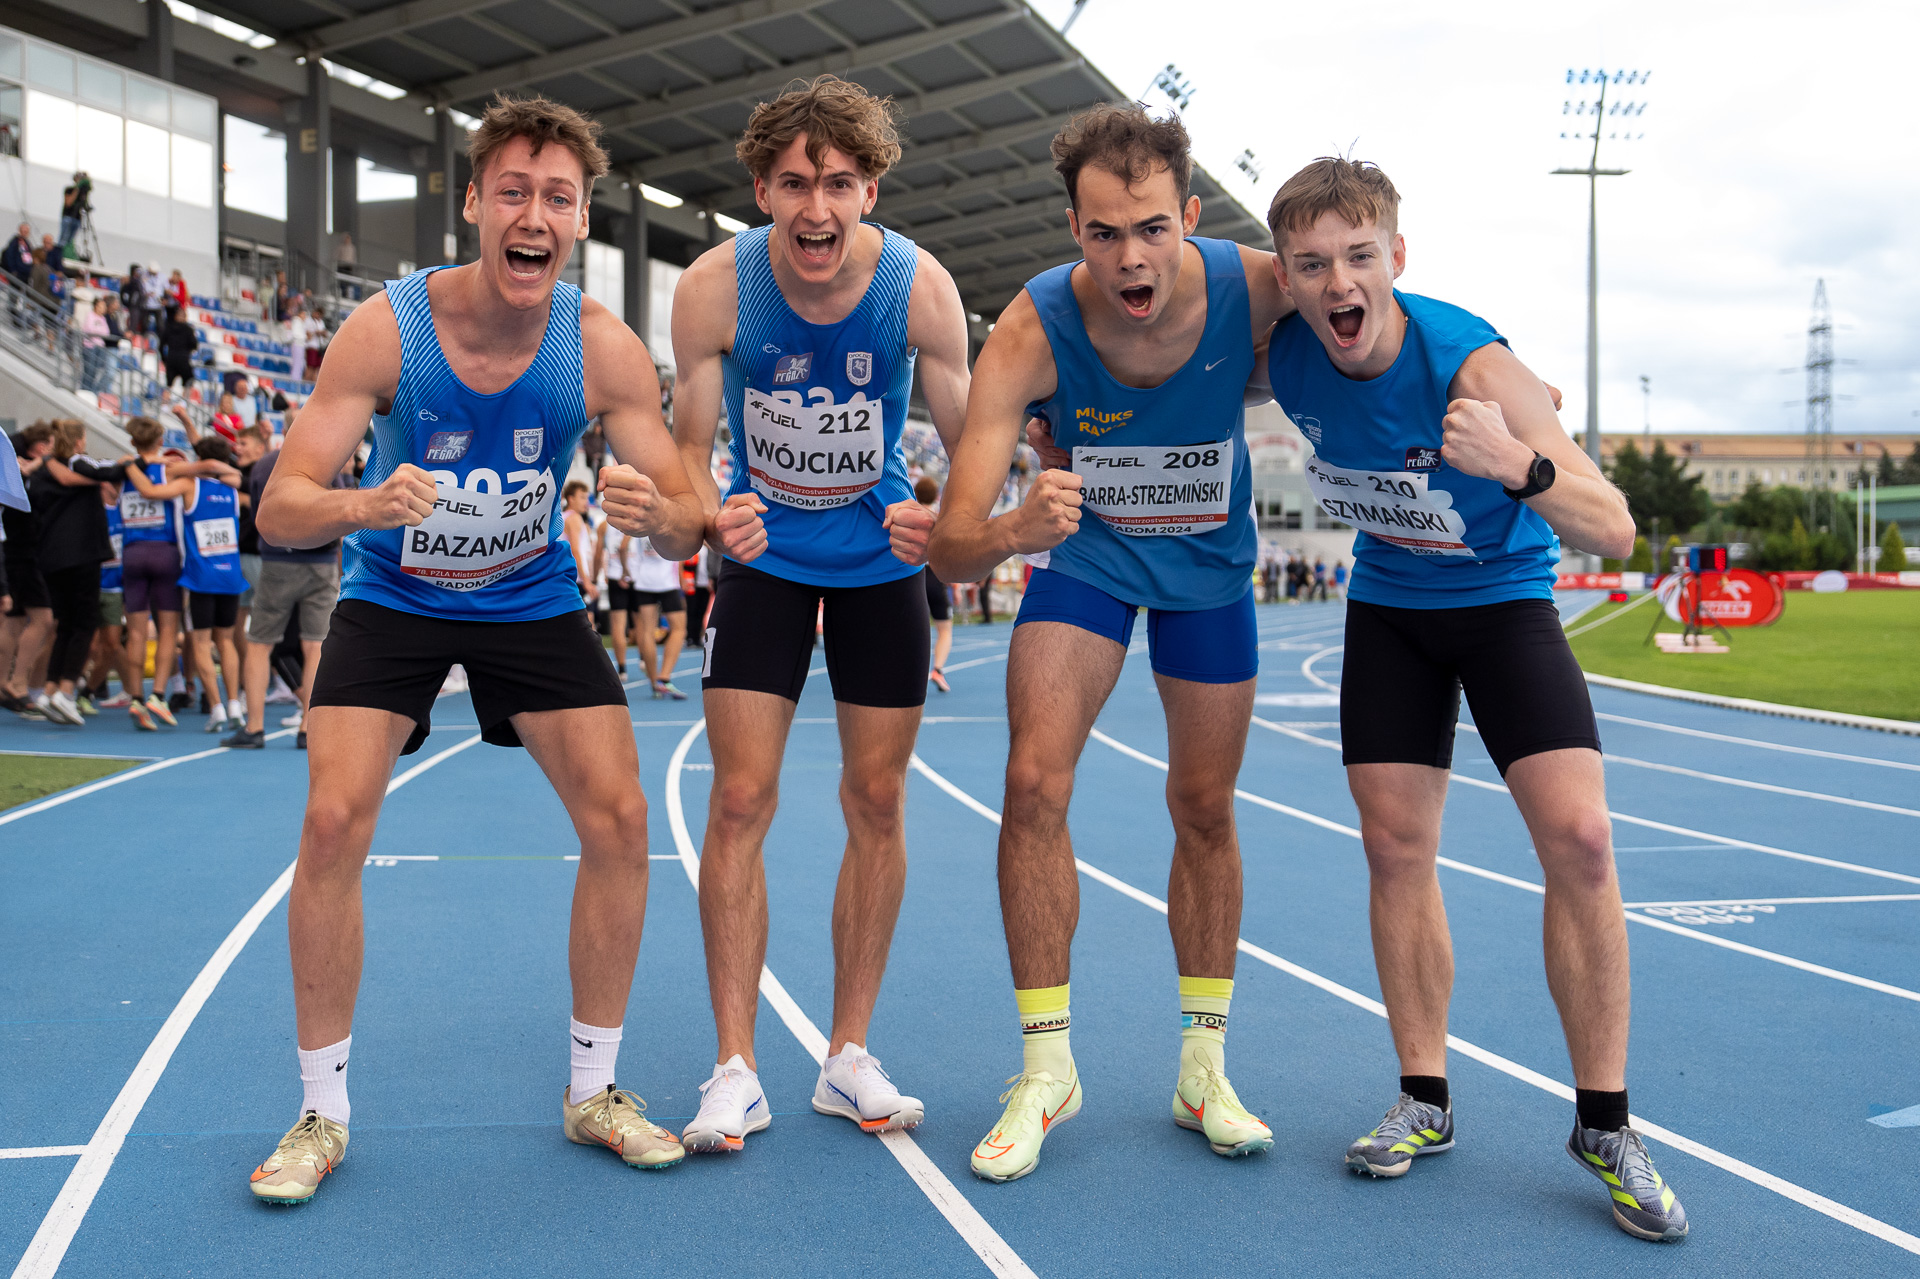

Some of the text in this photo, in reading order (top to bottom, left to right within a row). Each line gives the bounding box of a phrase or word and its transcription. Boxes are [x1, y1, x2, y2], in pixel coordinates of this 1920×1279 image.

[750, 400, 802, 430] 4F FUEL
[818, 409, 871, 434] 212
[1076, 407, 1133, 424] MLUKS
[750, 434, 877, 474] WÓJCIAK
[1079, 455, 1146, 469] 4F FUEL
[1162, 449, 1220, 469] 208
[767, 479, 783, 489] PZLA
[783, 485, 829, 496] Mistrzostwa
[830, 487, 854, 495] Polski
[855, 483, 870, 491] U20
[1318, 471, 1359, 487] FUEL
[1367, 475, 1418, 500] 210
[432, 498, 484, 517] FUEL
[501, 482, 548, 519] 209
[772, 490, 850, 507] RADOM 2024
[129, 502, 157, 517] 275
[1322, 498, 1450, 533] SZYMAŃSKI
[1121, 516, 1171, 524] Mistrzostwa
[1159, 525, 1192, 534] 2024
[205, 530, 230, 546] 288
[411, 513, 547, 558] BAZANIAK
[415, 568, 428, 576] 78.
[430, 570, 450, 578] PZLA
[452, 566, 500, 578] Mistrzostwa
[501, 555, 522, 569] Polski
[436, 566, 516, 590] RADOM 2024
